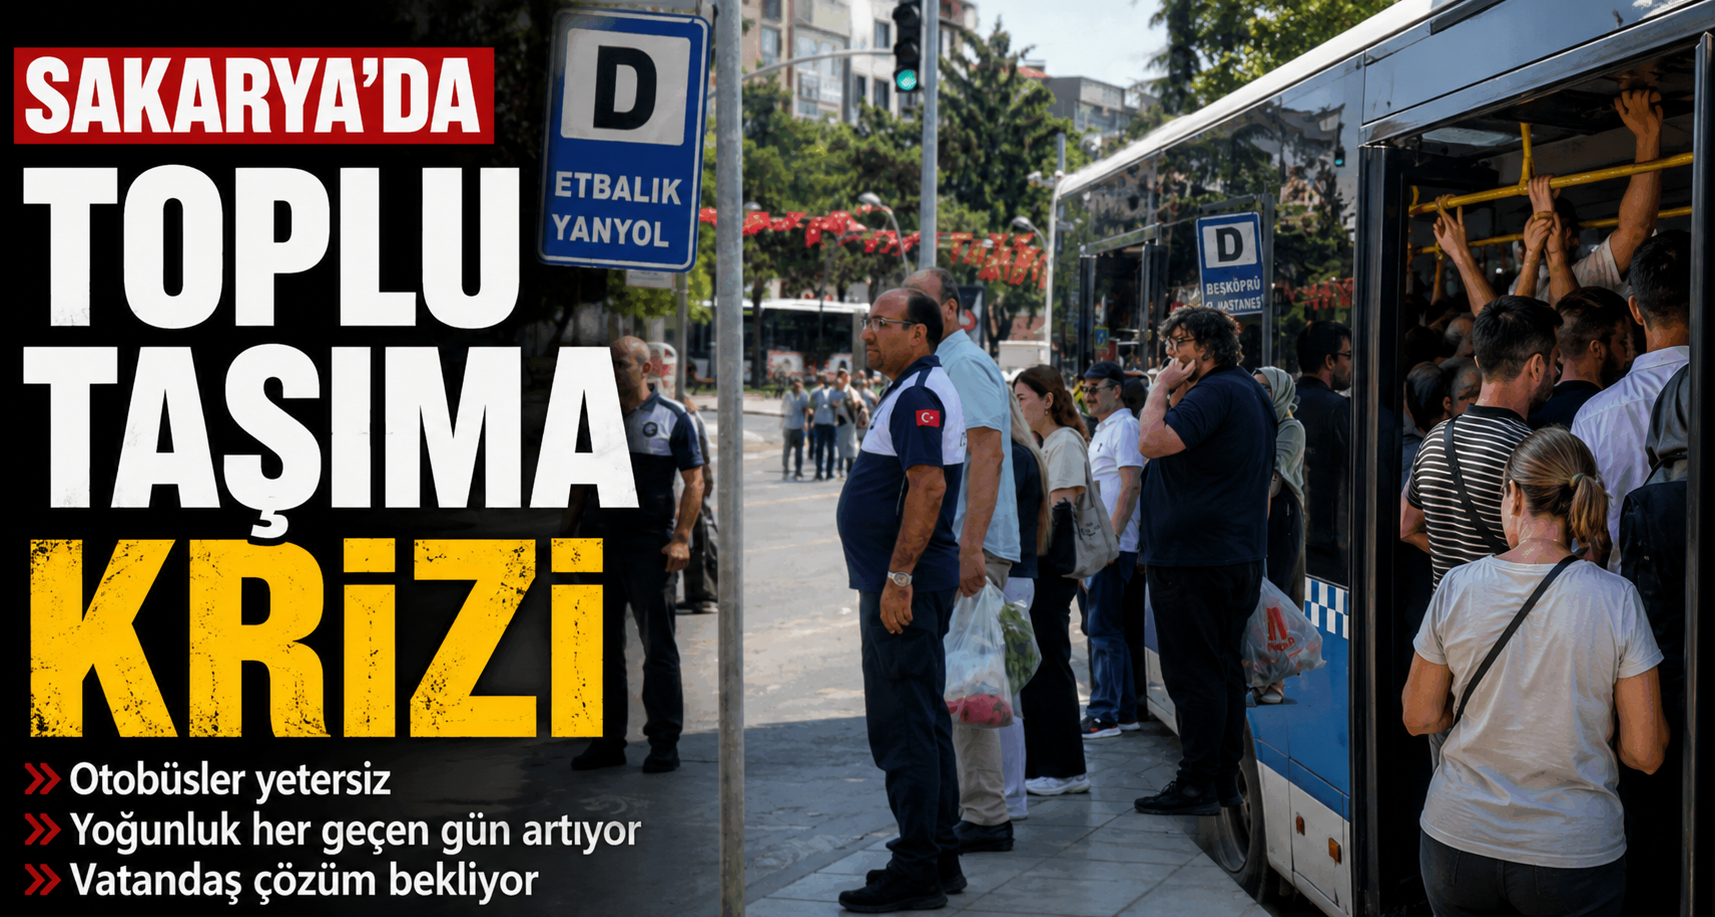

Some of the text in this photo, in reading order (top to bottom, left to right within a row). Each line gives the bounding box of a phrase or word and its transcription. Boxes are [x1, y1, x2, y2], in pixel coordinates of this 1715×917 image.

[593, 45, 657, 131] D
[554, 171, 682, 206] ETBALIK
[551, 213, 670, 249] YANYOL
[1215, 226, 1244, 262] D
[1206, 275, 1261, 296] BEŞKÖPRÜ
